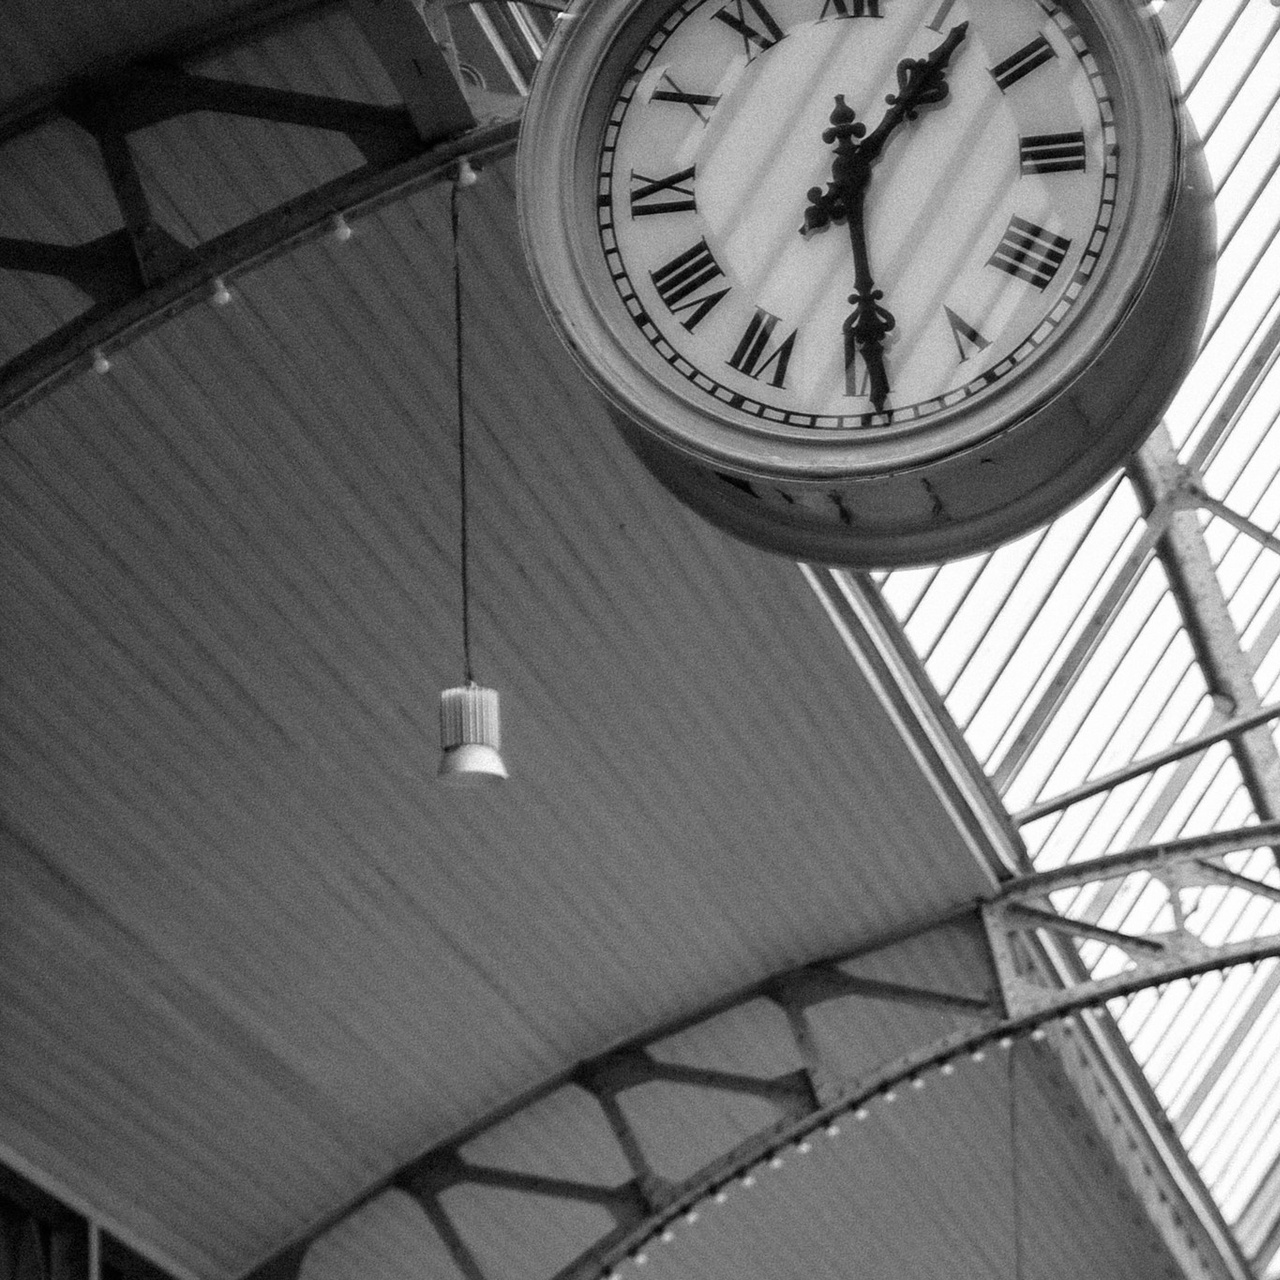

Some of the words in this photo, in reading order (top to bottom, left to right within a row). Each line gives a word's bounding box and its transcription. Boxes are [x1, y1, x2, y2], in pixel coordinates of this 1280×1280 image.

[986, 32, 1058, 94] II
[649, 63, 722, 128] X
[1018, 130, 1086, 178] III
[629, 163, 699, 221] IX
[984, 212, 1073, 293] IIII
[649, 236, 733, 336] VIII
[724, 304, 798, 391] VII
[942, 303, 993, 367] V
